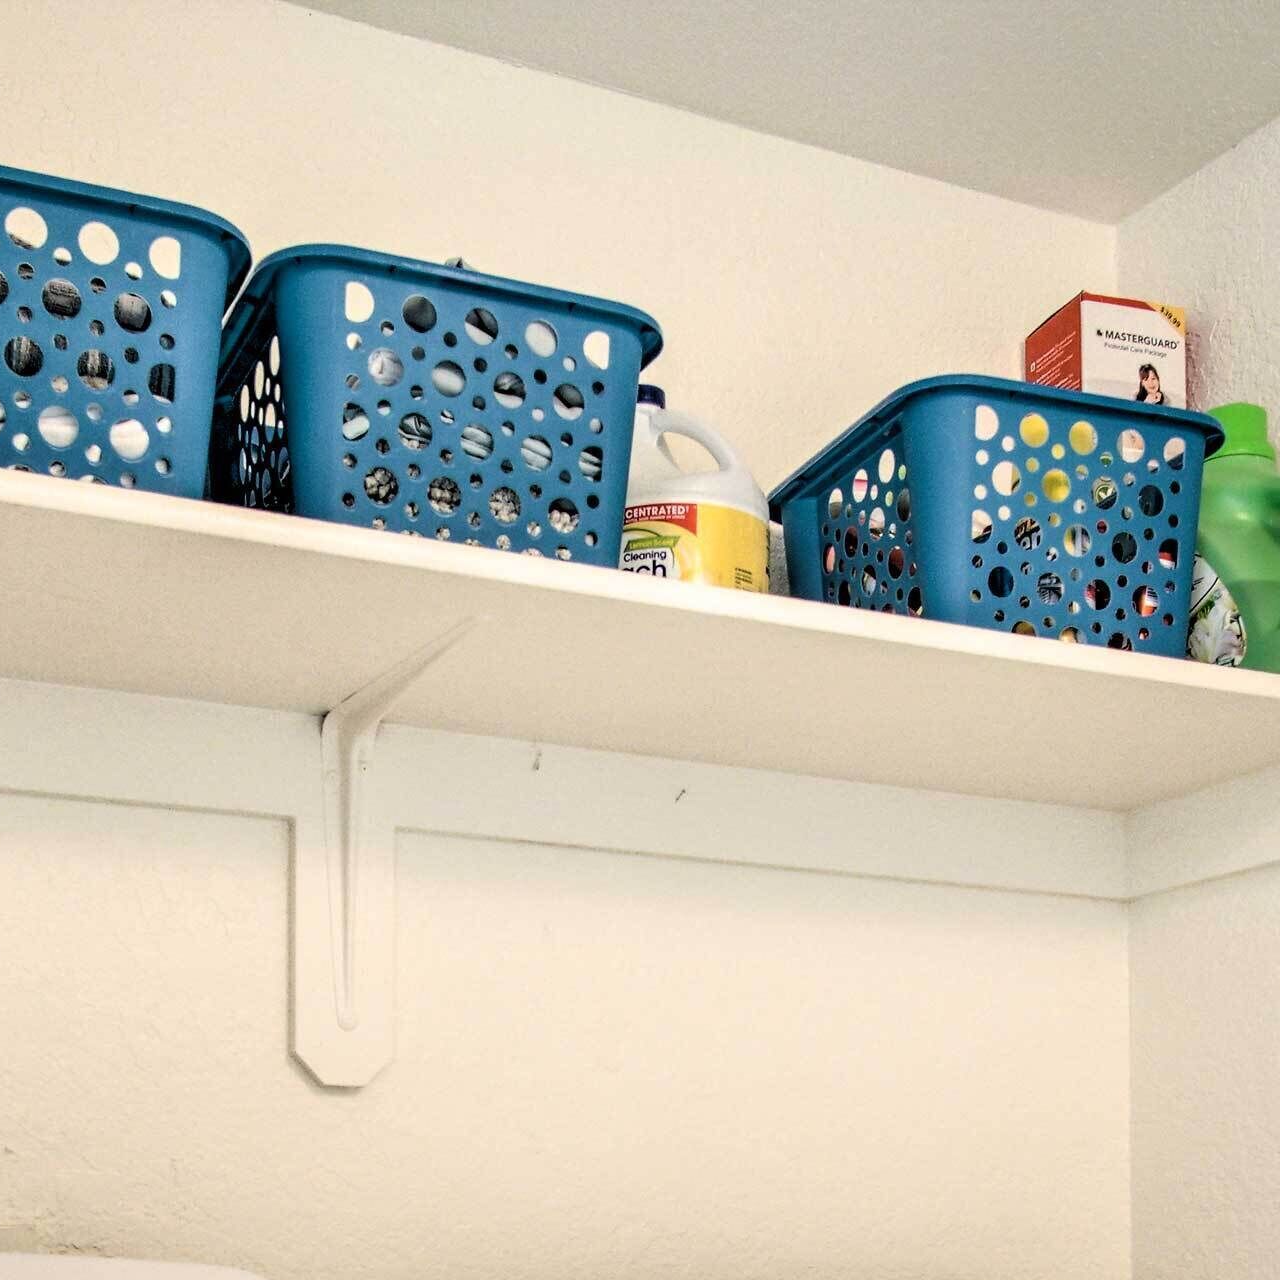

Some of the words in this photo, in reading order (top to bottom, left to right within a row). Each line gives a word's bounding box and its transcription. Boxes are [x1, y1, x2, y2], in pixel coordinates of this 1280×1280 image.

[1105, 330, 1178, 350] MASTERGUARD
[625, 505, 684, 519] CENTRATED
[623, 550, 667, 562] Cleaning
